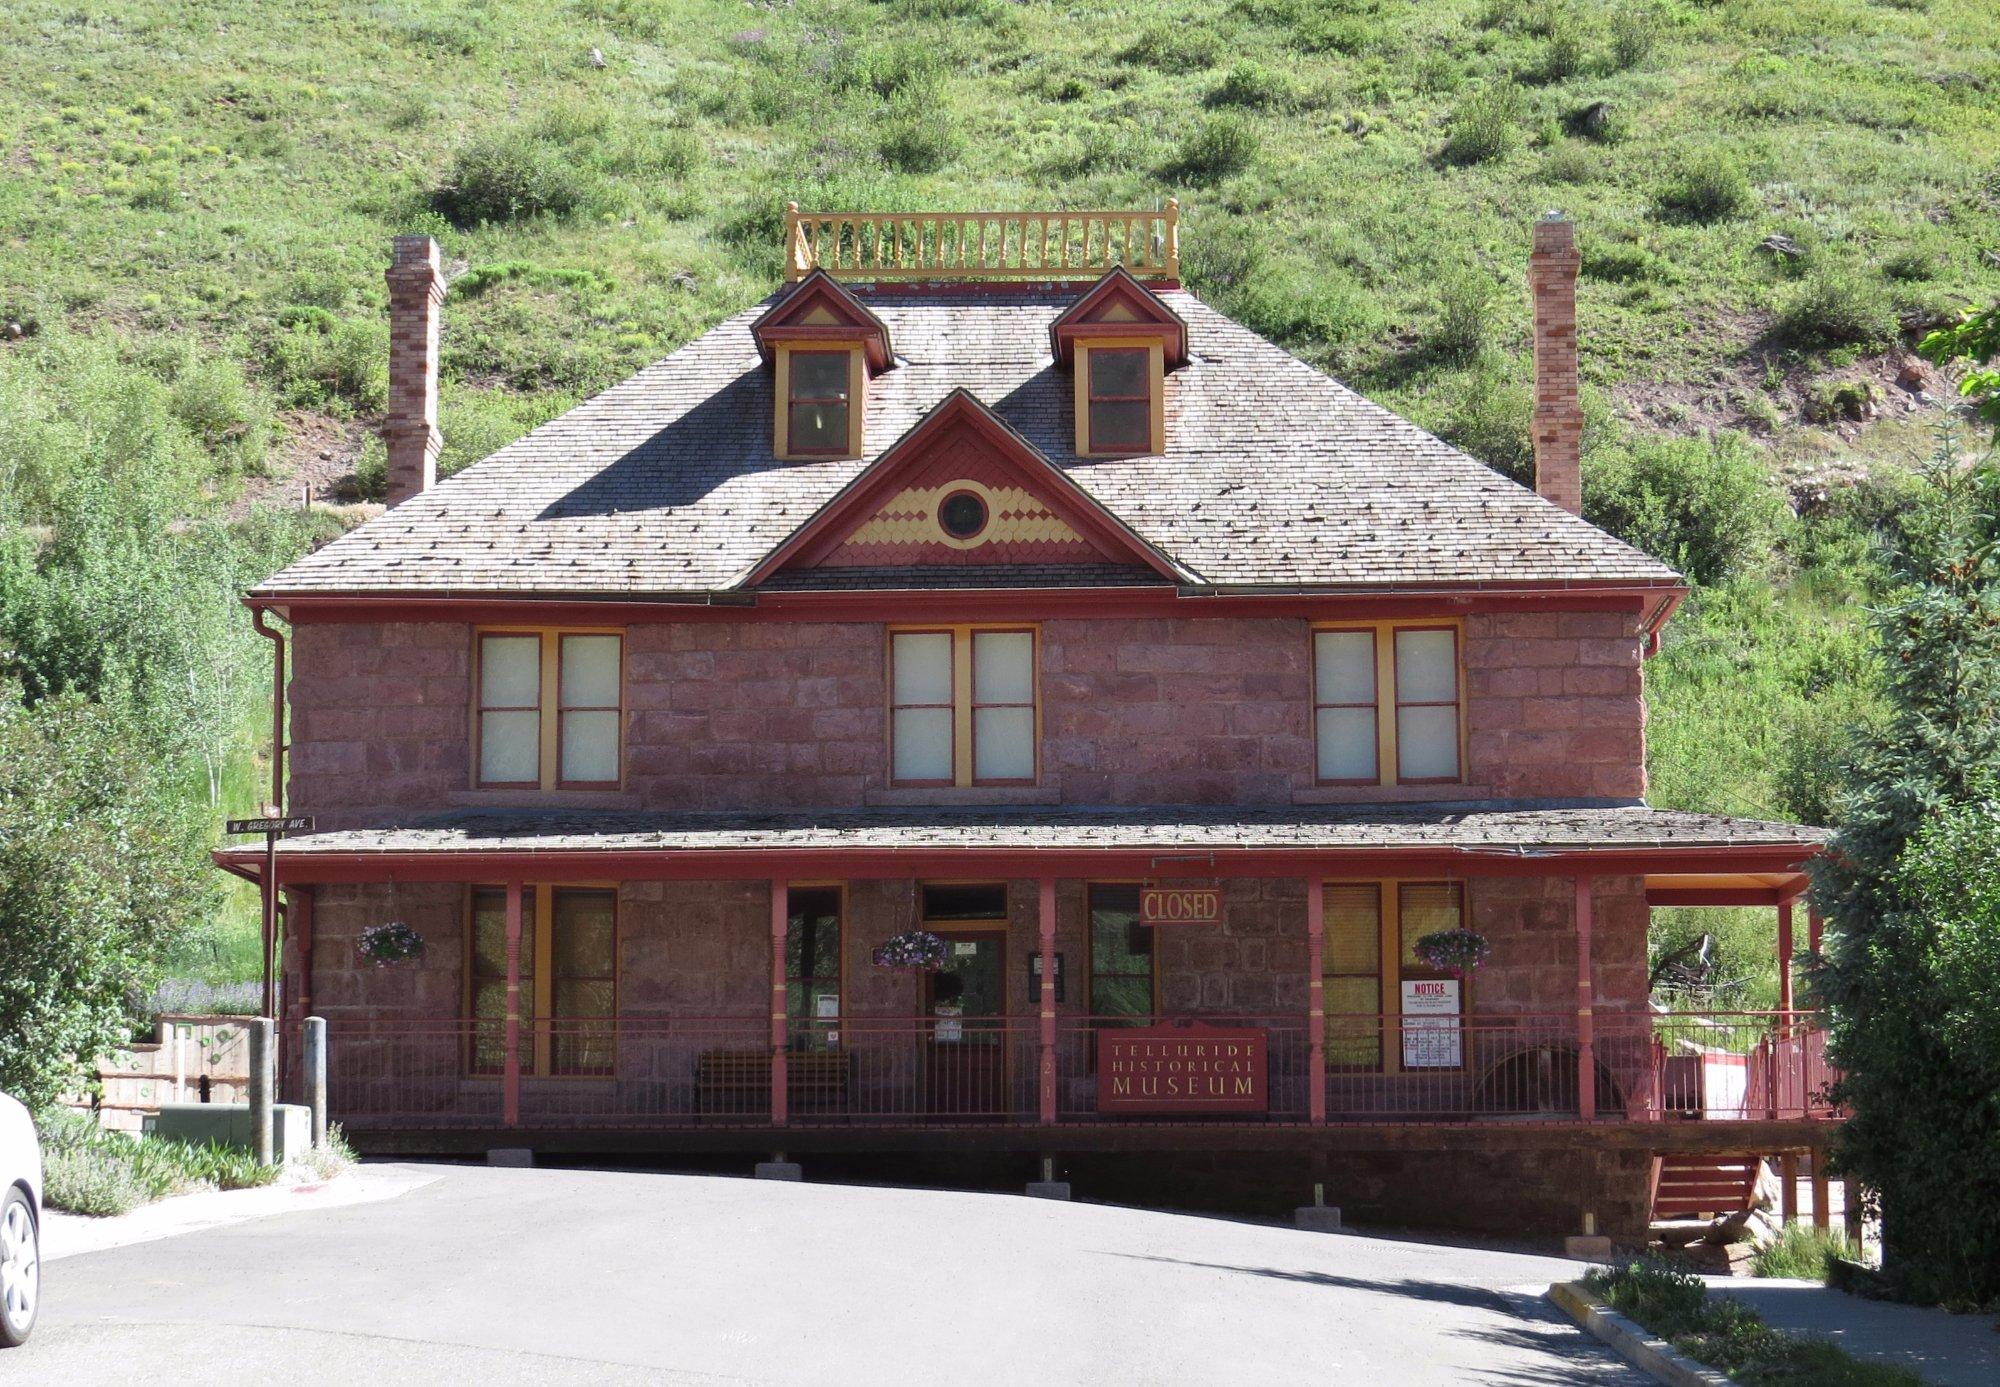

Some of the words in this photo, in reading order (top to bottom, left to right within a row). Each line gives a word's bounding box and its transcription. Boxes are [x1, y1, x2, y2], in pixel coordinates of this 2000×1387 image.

[232, 822, 244, 832] W.
[247, 819, 285, 831] GREGORY
[289, 818, 308, 829] AVE.
[1144, 892, 1218, 920] CLOSED
[1414, 983, 1446, 995] NOTICE
[1112, 1045, 1255, 1057] TELLURIDE
[1112, 1060, 1255, 1073] HISTORICAL
[1112, 1077, 1254, 1095] MUSEUM
